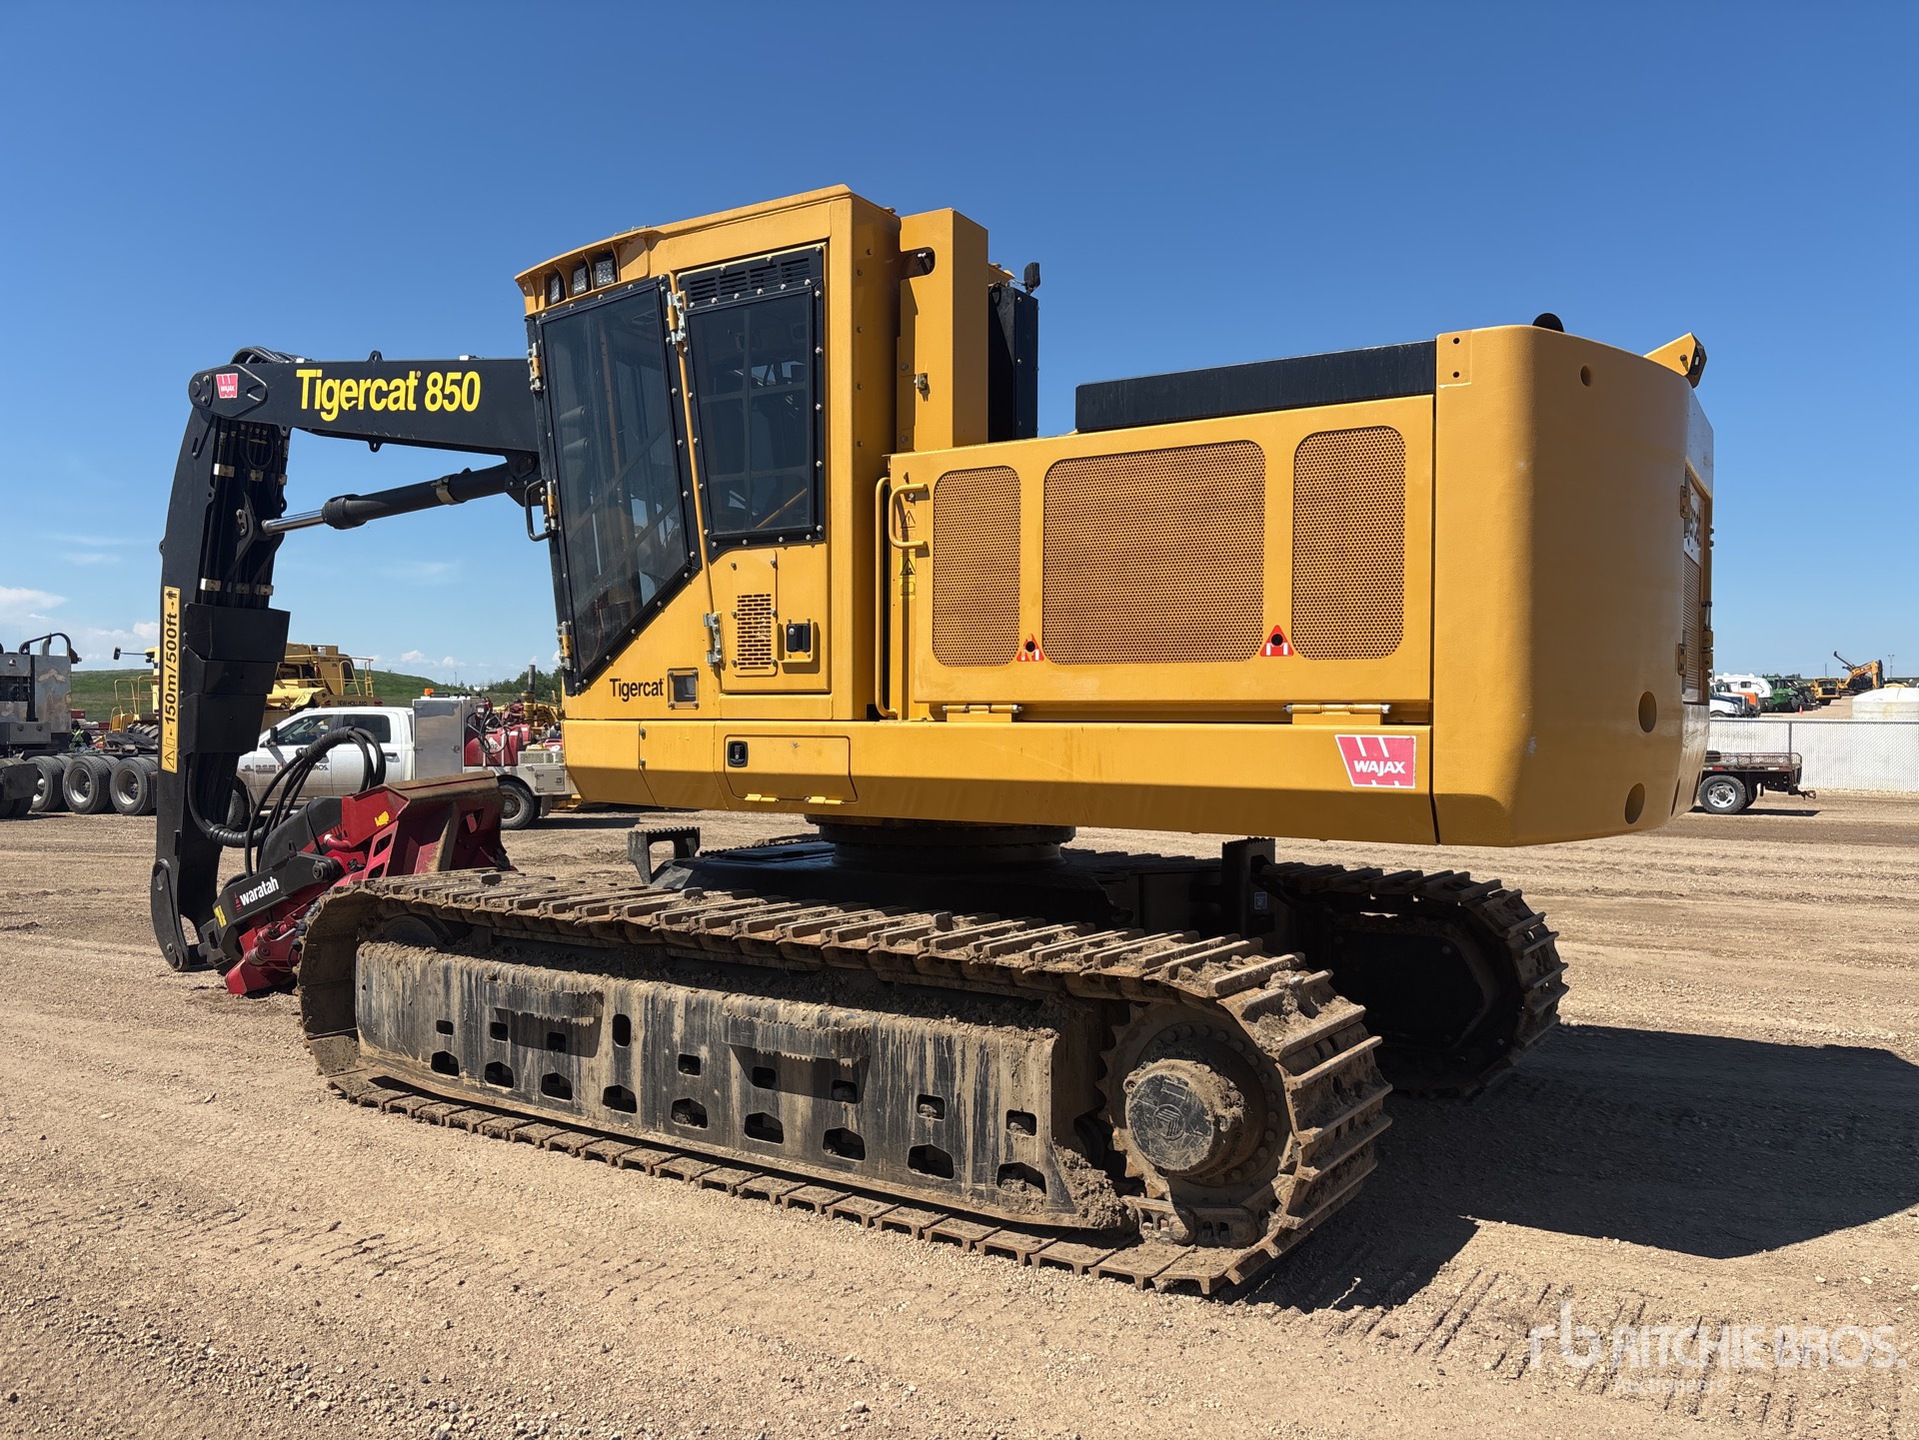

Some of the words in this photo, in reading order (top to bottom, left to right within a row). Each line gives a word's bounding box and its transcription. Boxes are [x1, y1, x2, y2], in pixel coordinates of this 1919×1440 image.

[296, 368, 418, 422] Tigercat
[424, 371, 481, 412] 850
[609, 678, 664, 702] Tigercat
[1353, 759, 1406, 777] WAJAX
[239, 876, 280, 906] waratah
